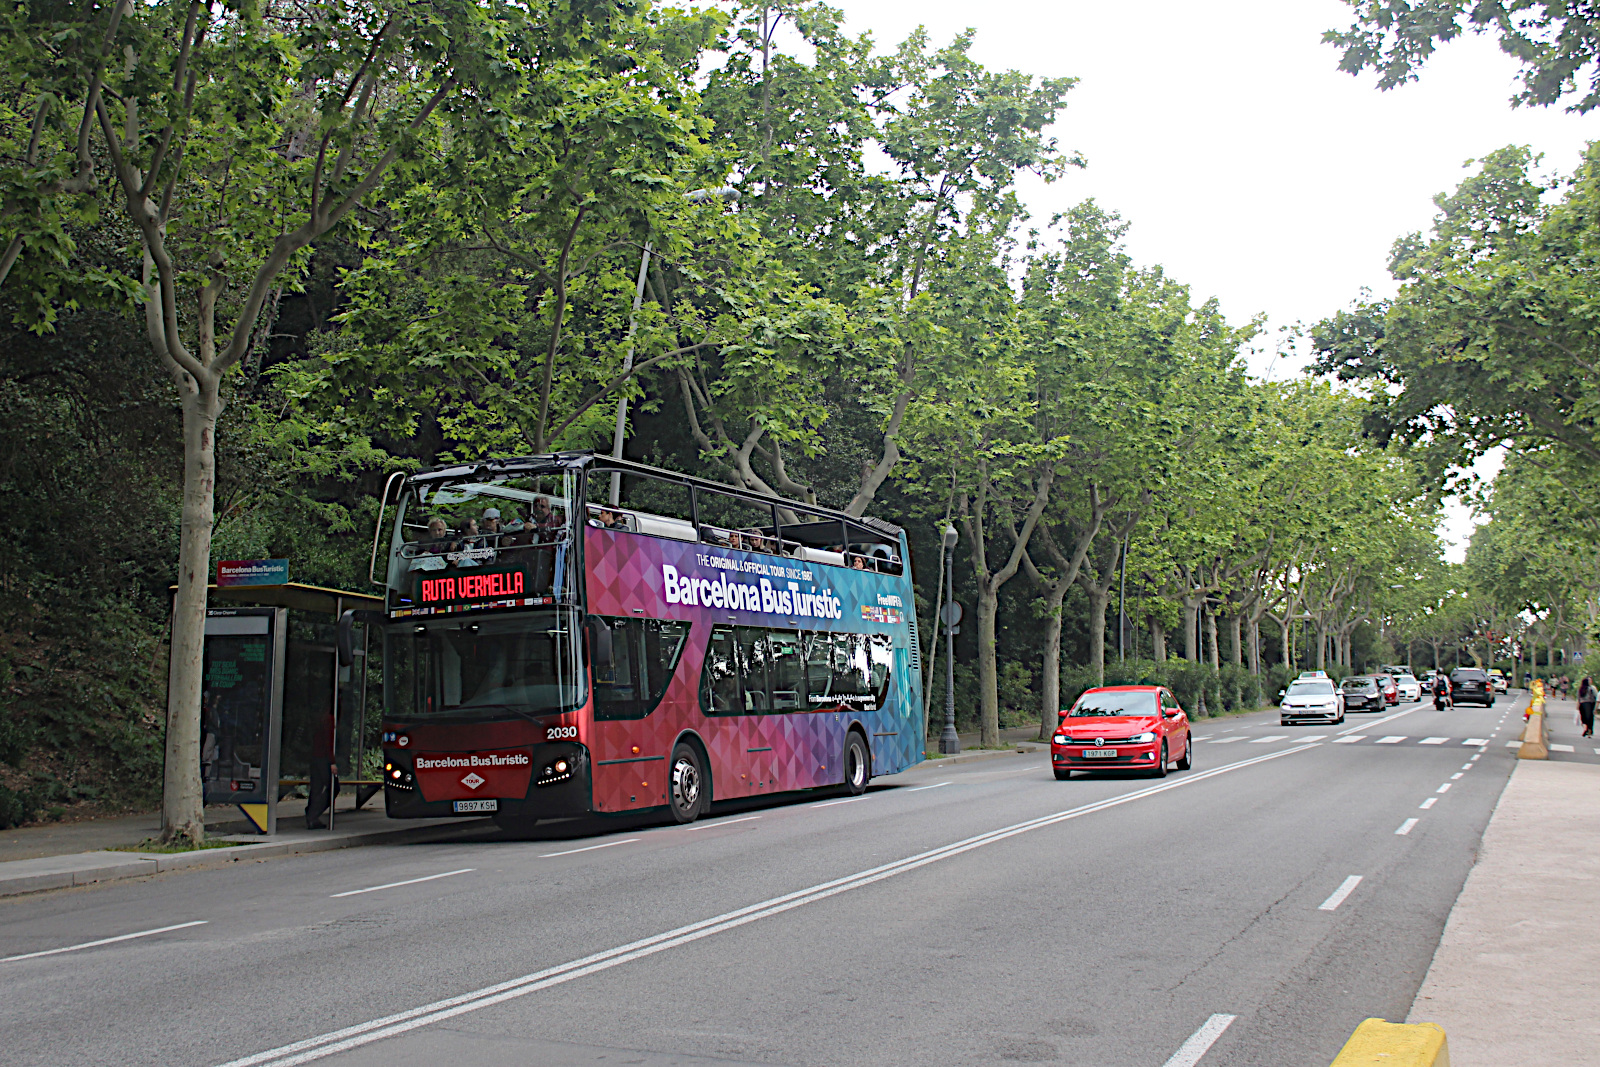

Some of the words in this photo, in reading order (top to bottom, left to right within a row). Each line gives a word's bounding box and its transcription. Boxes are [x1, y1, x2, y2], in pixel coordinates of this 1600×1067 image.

[221, 566, 251, 574] Barcelona
[696, 553, 710, 565] THE
[710, 556, 739, 571] ORIGINAL
[739, 560, 744, 571] &
[744, 561, 770, 576] OFFICIAL
[769, 565, 786, 577] TOUR
[785, 567, 801, 580] SINCE
[801, 571, 813, 581] 1987
[422, 577, 456, 602] RUTA
[458, 571, 524, 598] VERMELLA
[662, 564, 762, 612] Barcelona
[547, 726, 577, 739] 2030
[416, 757, 470, 769] Barcelona
[458, 802, 478, 811] 9897
[480, 801, 496, 810] KSH
